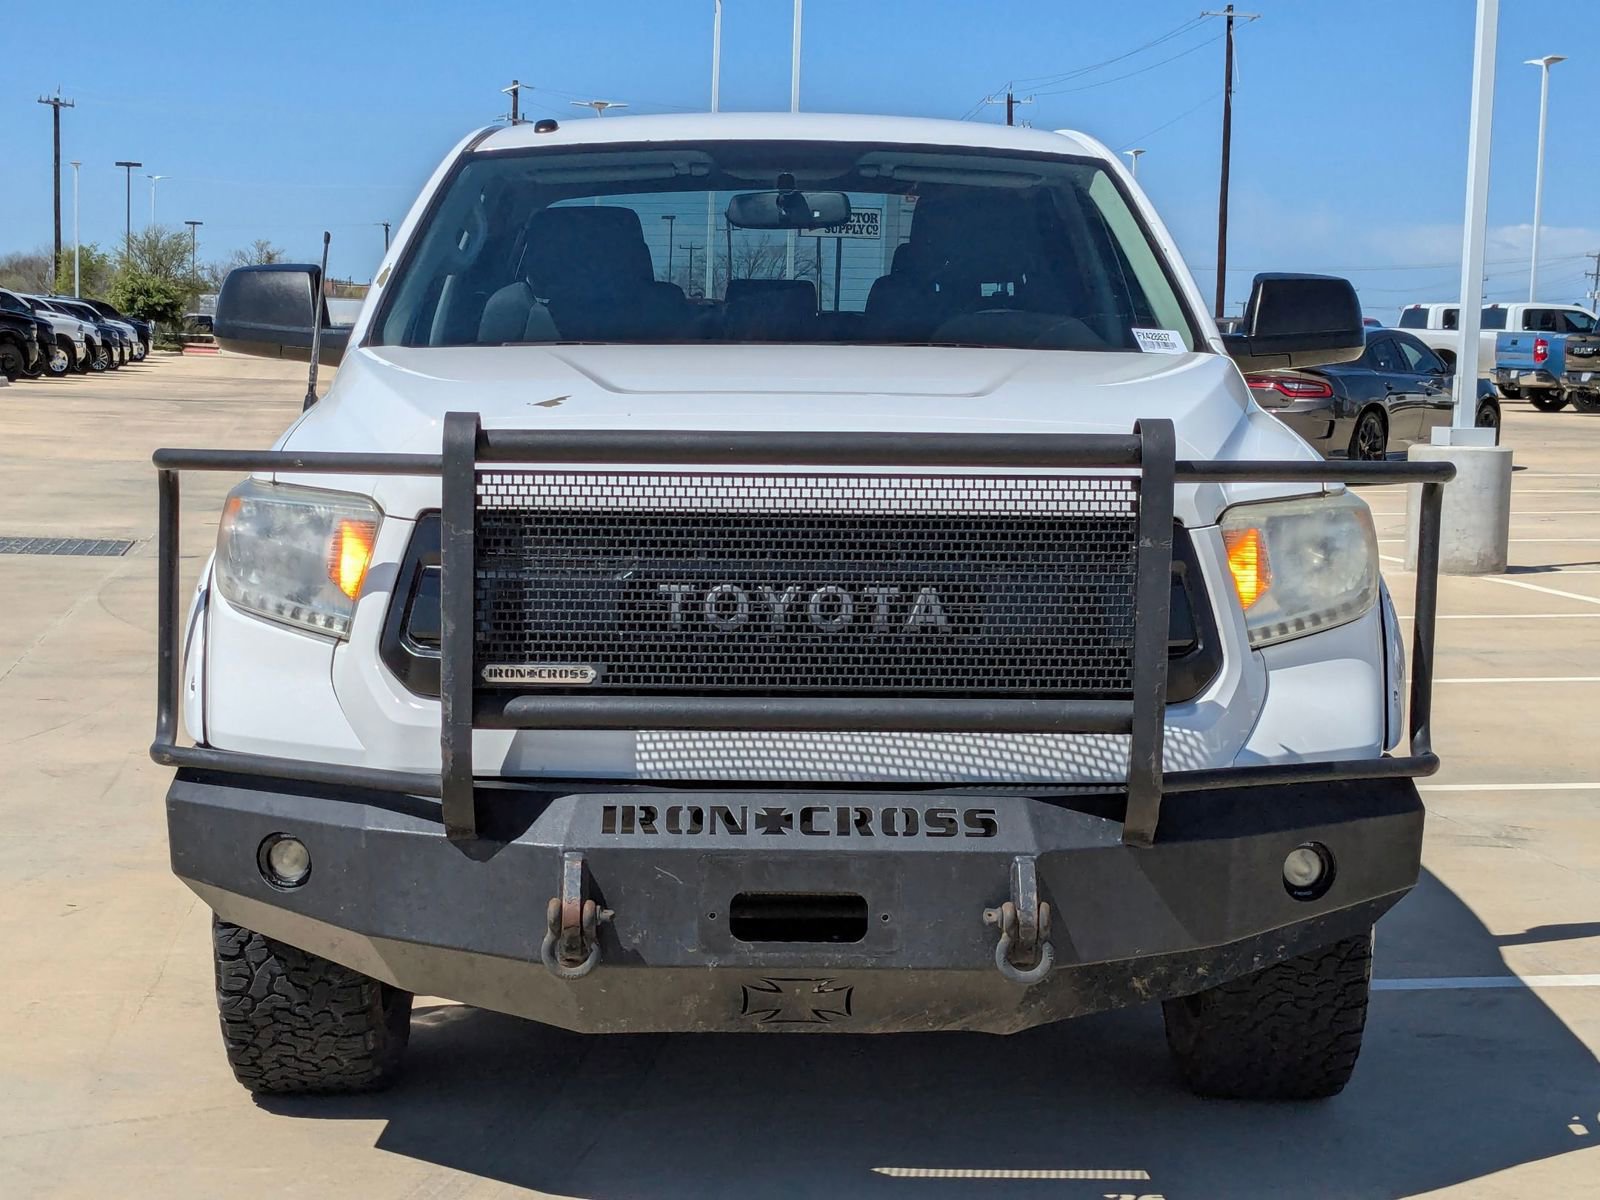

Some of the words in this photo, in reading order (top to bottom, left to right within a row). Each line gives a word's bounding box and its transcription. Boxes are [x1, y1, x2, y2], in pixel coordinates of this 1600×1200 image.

[849, 212, 878, 224] CTOR
[658, 583, 950, 632] TOYOTA
[488, 668, 526, 679] IRON
[538, 668, 589, 679] CROSS
[601, 805, 748, 835] IRON
[799, 806, 999, 838] CROSS
